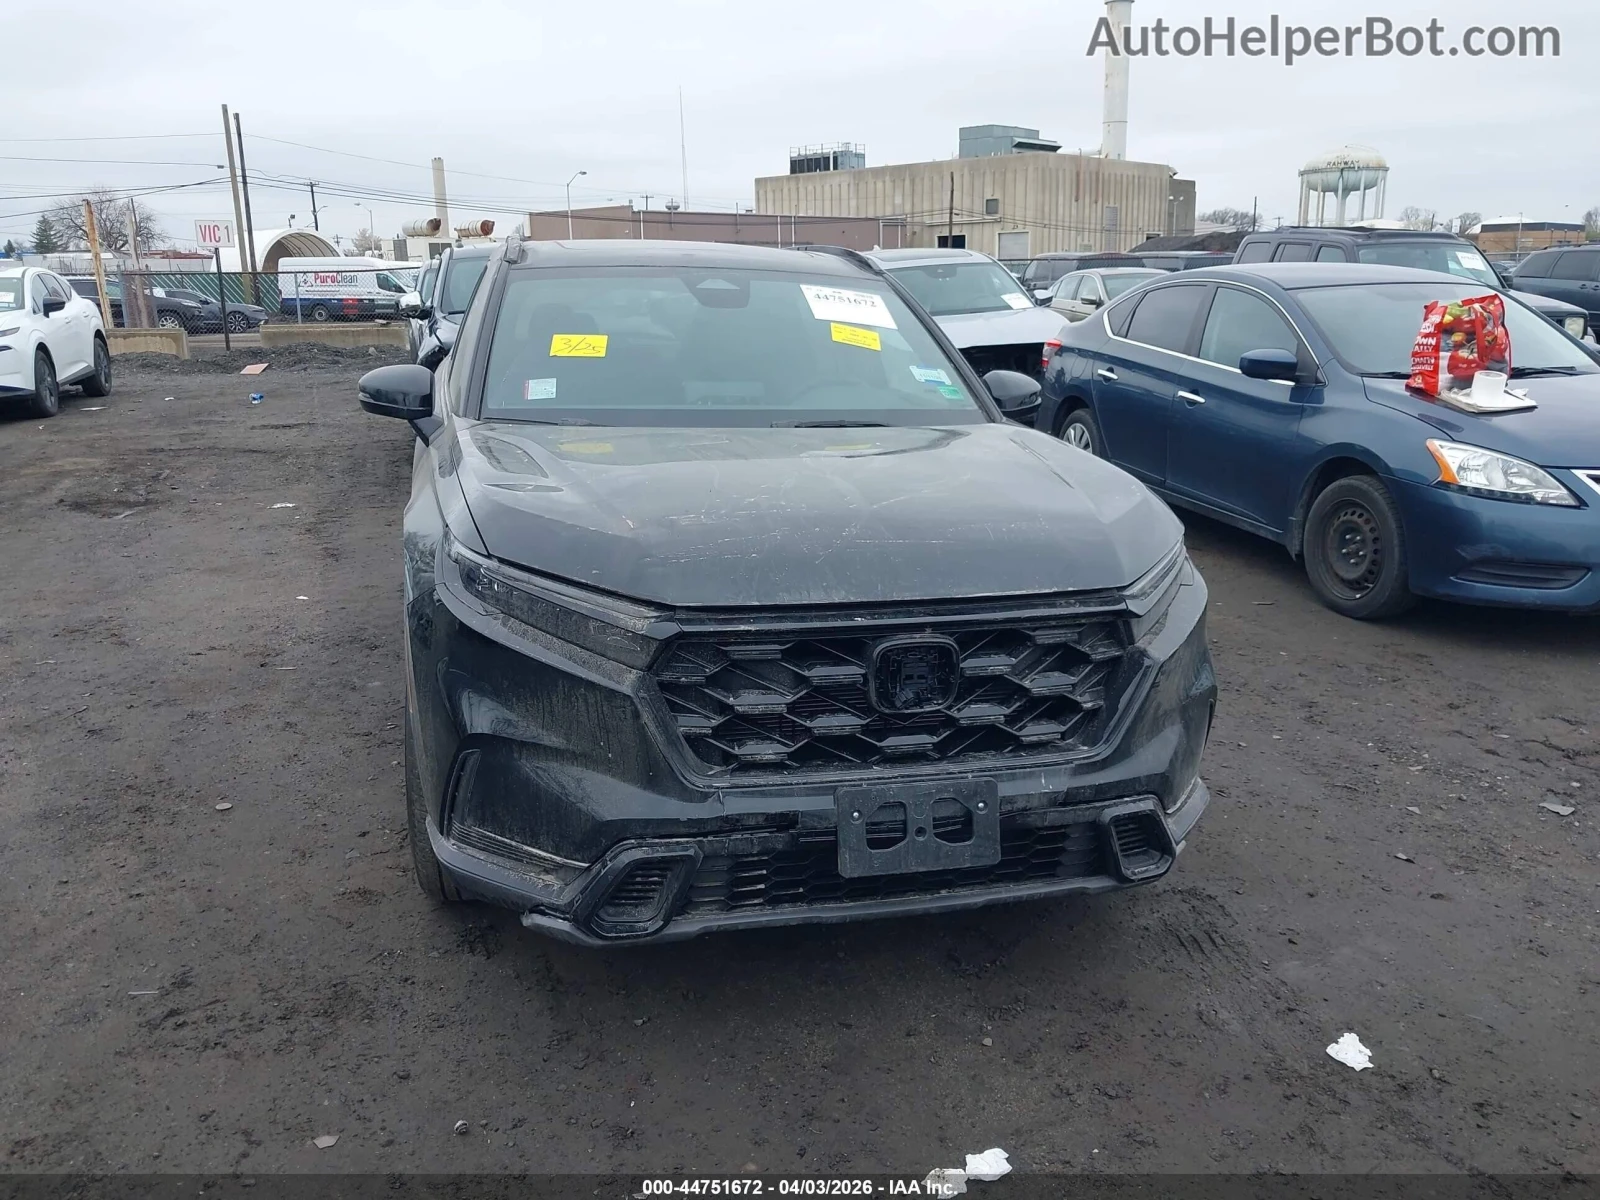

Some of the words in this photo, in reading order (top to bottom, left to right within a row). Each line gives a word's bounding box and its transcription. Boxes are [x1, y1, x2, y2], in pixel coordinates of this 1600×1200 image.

[1327, 159, 1360, 167] RAHWAY
[198, 224, 221, 243] VIC
[224, 224, 231, 243] 1
[314, 271, 358, 284] PuroClean
[813, 293, 877, 308] 44751672
[553, 337, 606, 355] 3/25
